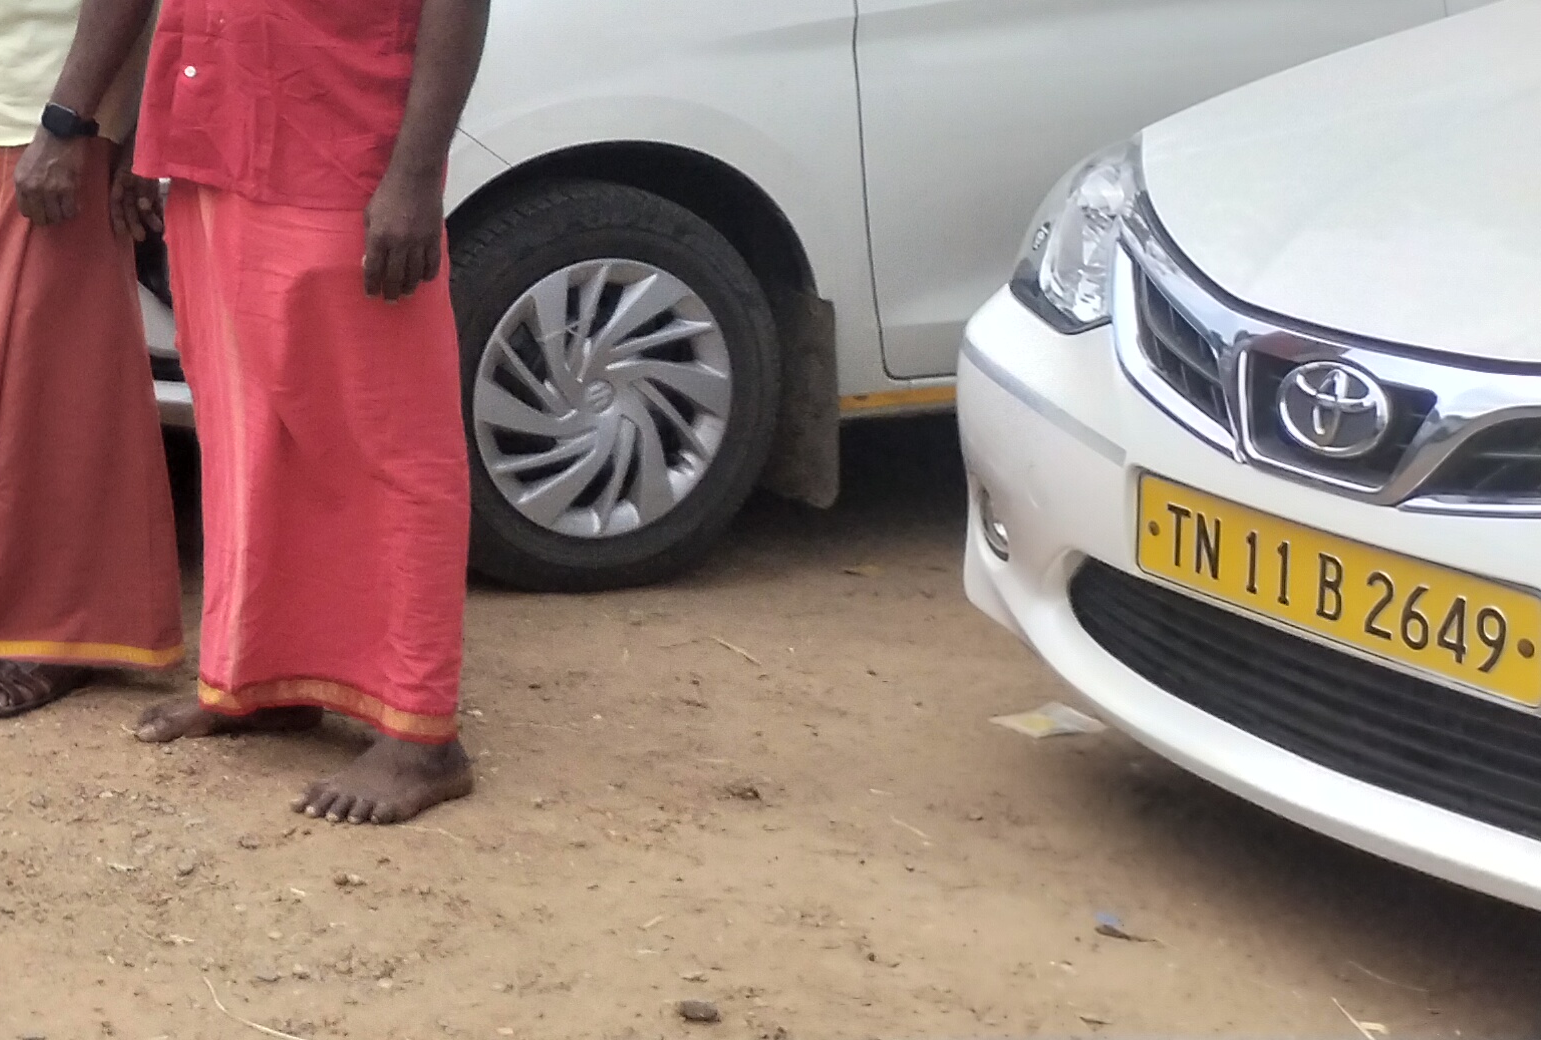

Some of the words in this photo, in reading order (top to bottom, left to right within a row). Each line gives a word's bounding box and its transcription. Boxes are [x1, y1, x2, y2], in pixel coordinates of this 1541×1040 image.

[1167, 502, 1222, 581] TN
[1244, 531, 1290, 607] 11
[1315, 553, 1344, 622] B
[1363, 571, 1508, 674] 2649
